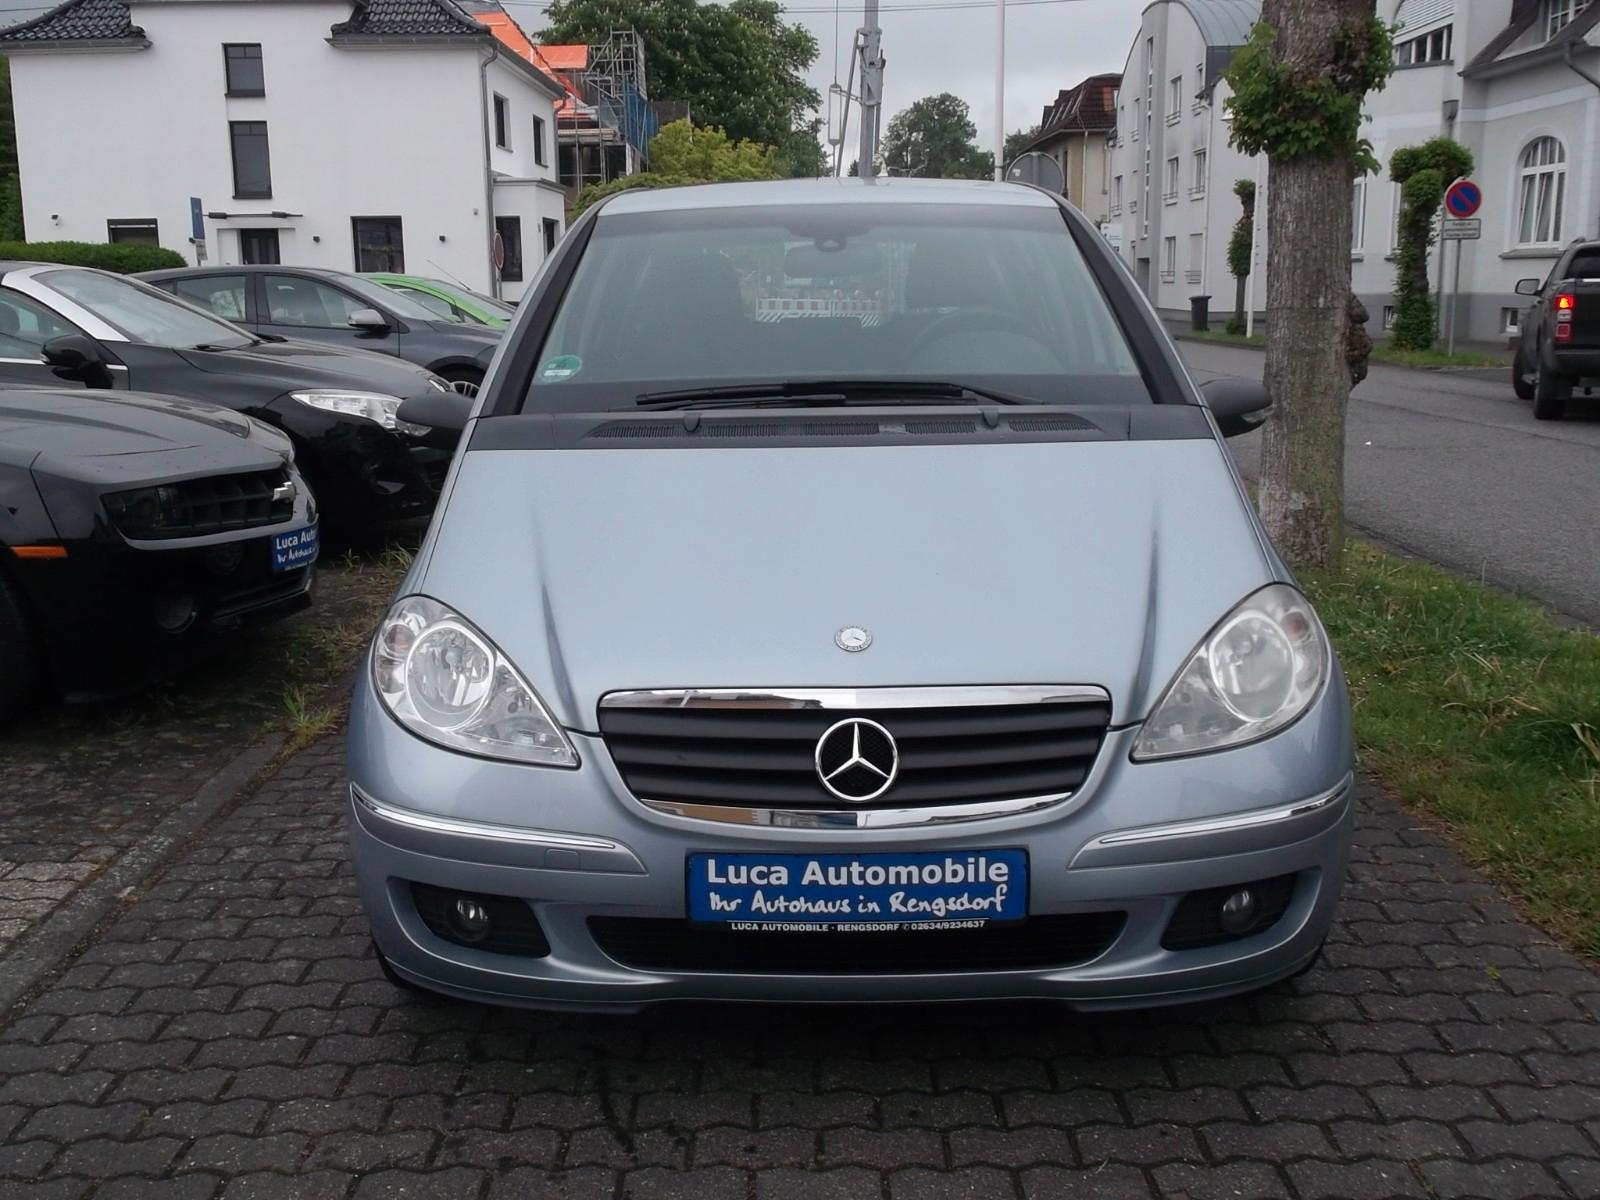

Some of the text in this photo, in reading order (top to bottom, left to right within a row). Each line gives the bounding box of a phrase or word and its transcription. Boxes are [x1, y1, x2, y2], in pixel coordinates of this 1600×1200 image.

[276, 536, 298, 549] Luca
[707, 857, 1009, 886] Luca Automobile
[709, 884, 1007, 917] Ihr Autohaus in Rengsdorf
[731, 920, 985, 932] LUCA AUTOMOBILE RENGSDORF 02634/9234637
